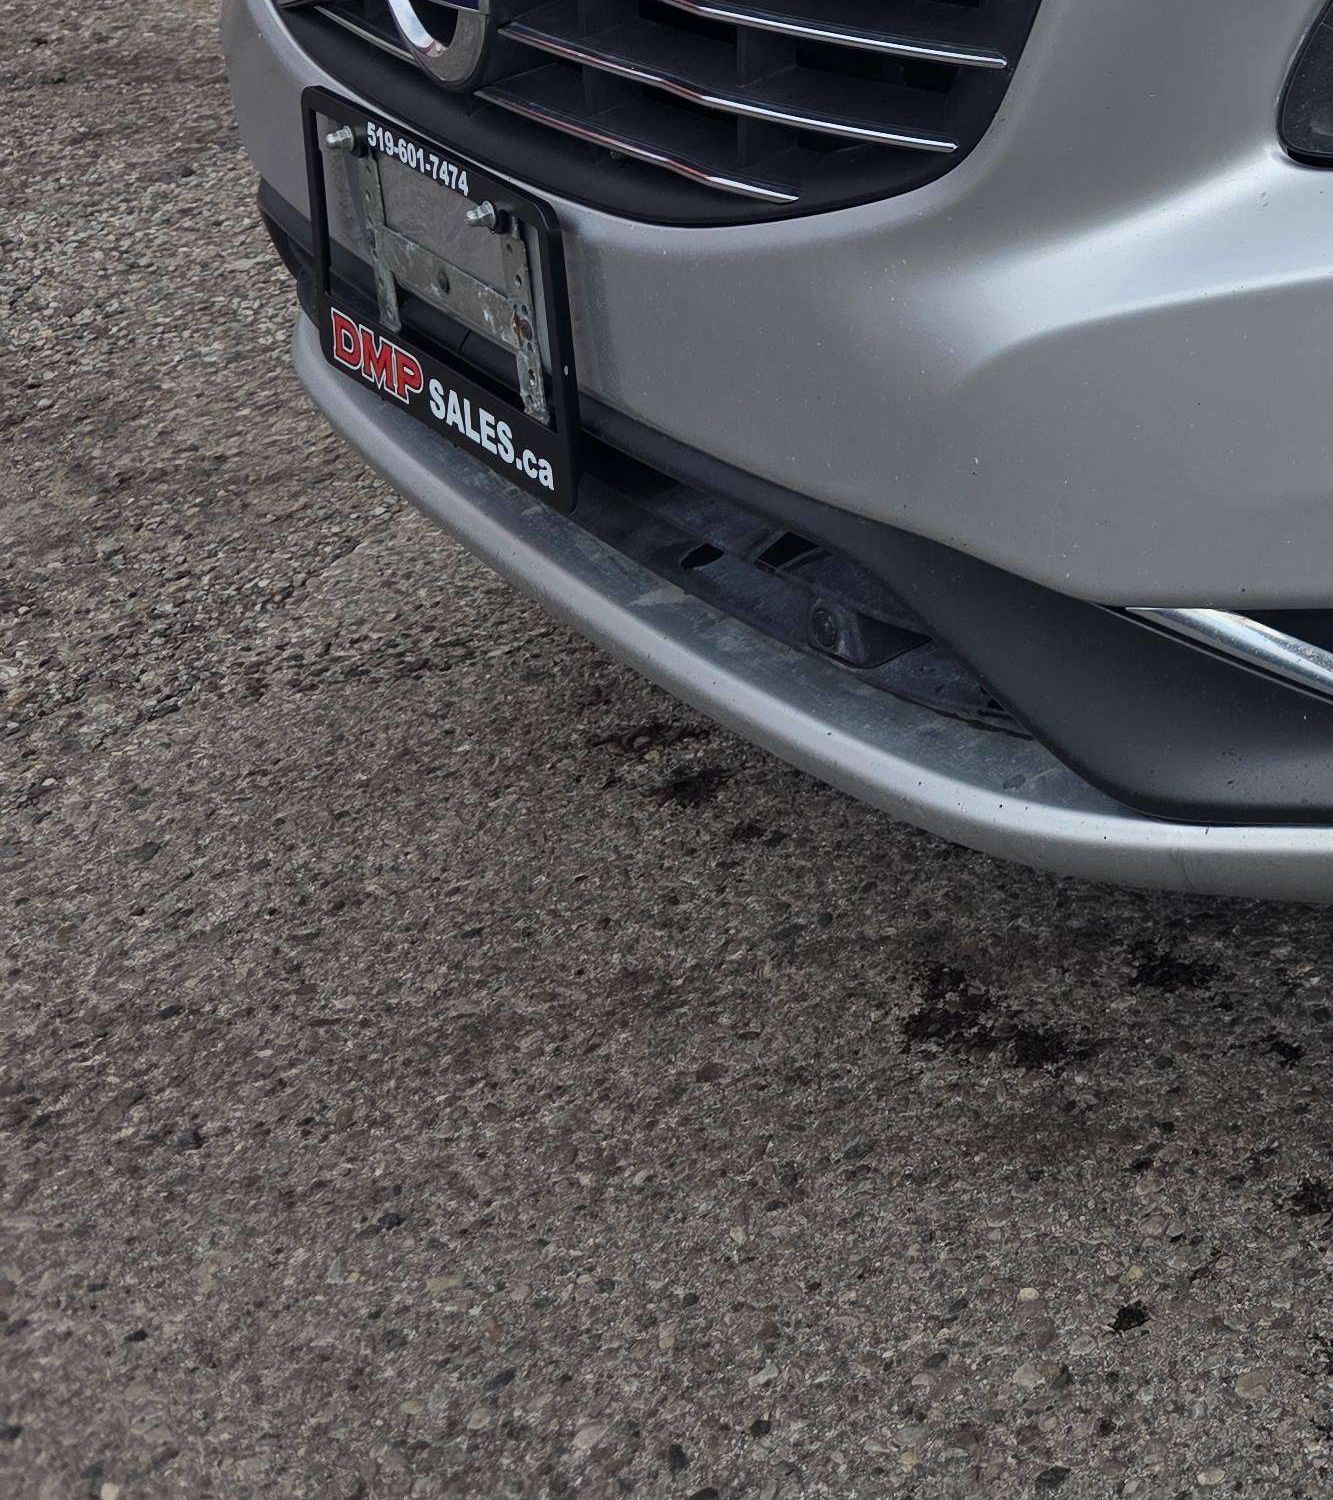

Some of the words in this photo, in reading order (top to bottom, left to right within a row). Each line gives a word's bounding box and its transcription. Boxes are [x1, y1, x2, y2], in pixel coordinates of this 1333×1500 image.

[367, 121, 470, 197] 519-601-7474
[330, 306, 424, 405] DMP
[428, 378, 555, 491] SALES.ca
